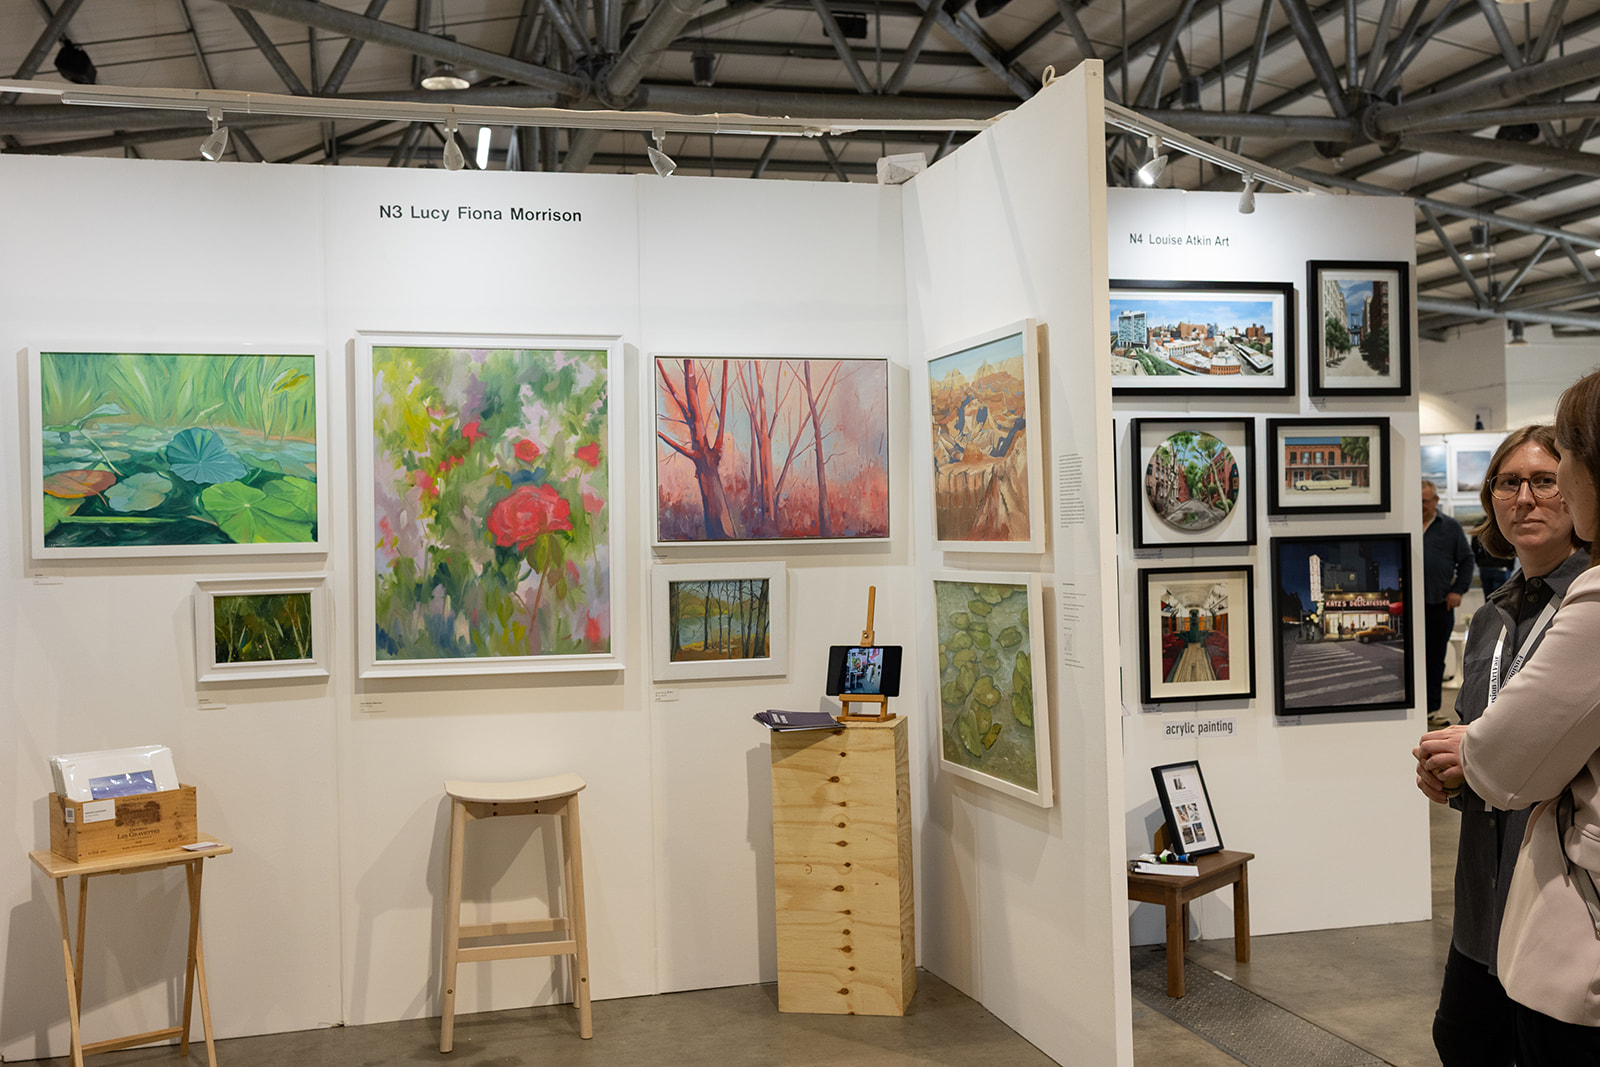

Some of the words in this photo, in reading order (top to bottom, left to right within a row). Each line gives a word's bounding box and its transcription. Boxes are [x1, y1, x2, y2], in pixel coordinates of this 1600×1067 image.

[379, 205, 402, 219] N3
[410, 205, 450, 222] Lucy
[458, 206, 502, 220] Fiona
[510, 207, 582, 222] Morrison
[1129, 233, 1143, 244] N4
[1149, 234, 1183, 245] Louise
[1186, 235, 1211, 246] Atkin
[1214, 236, 1230, 247] Art
[1166, 722, 1195, 736] acrylic
[1198, 720, 1233, 735] painting
